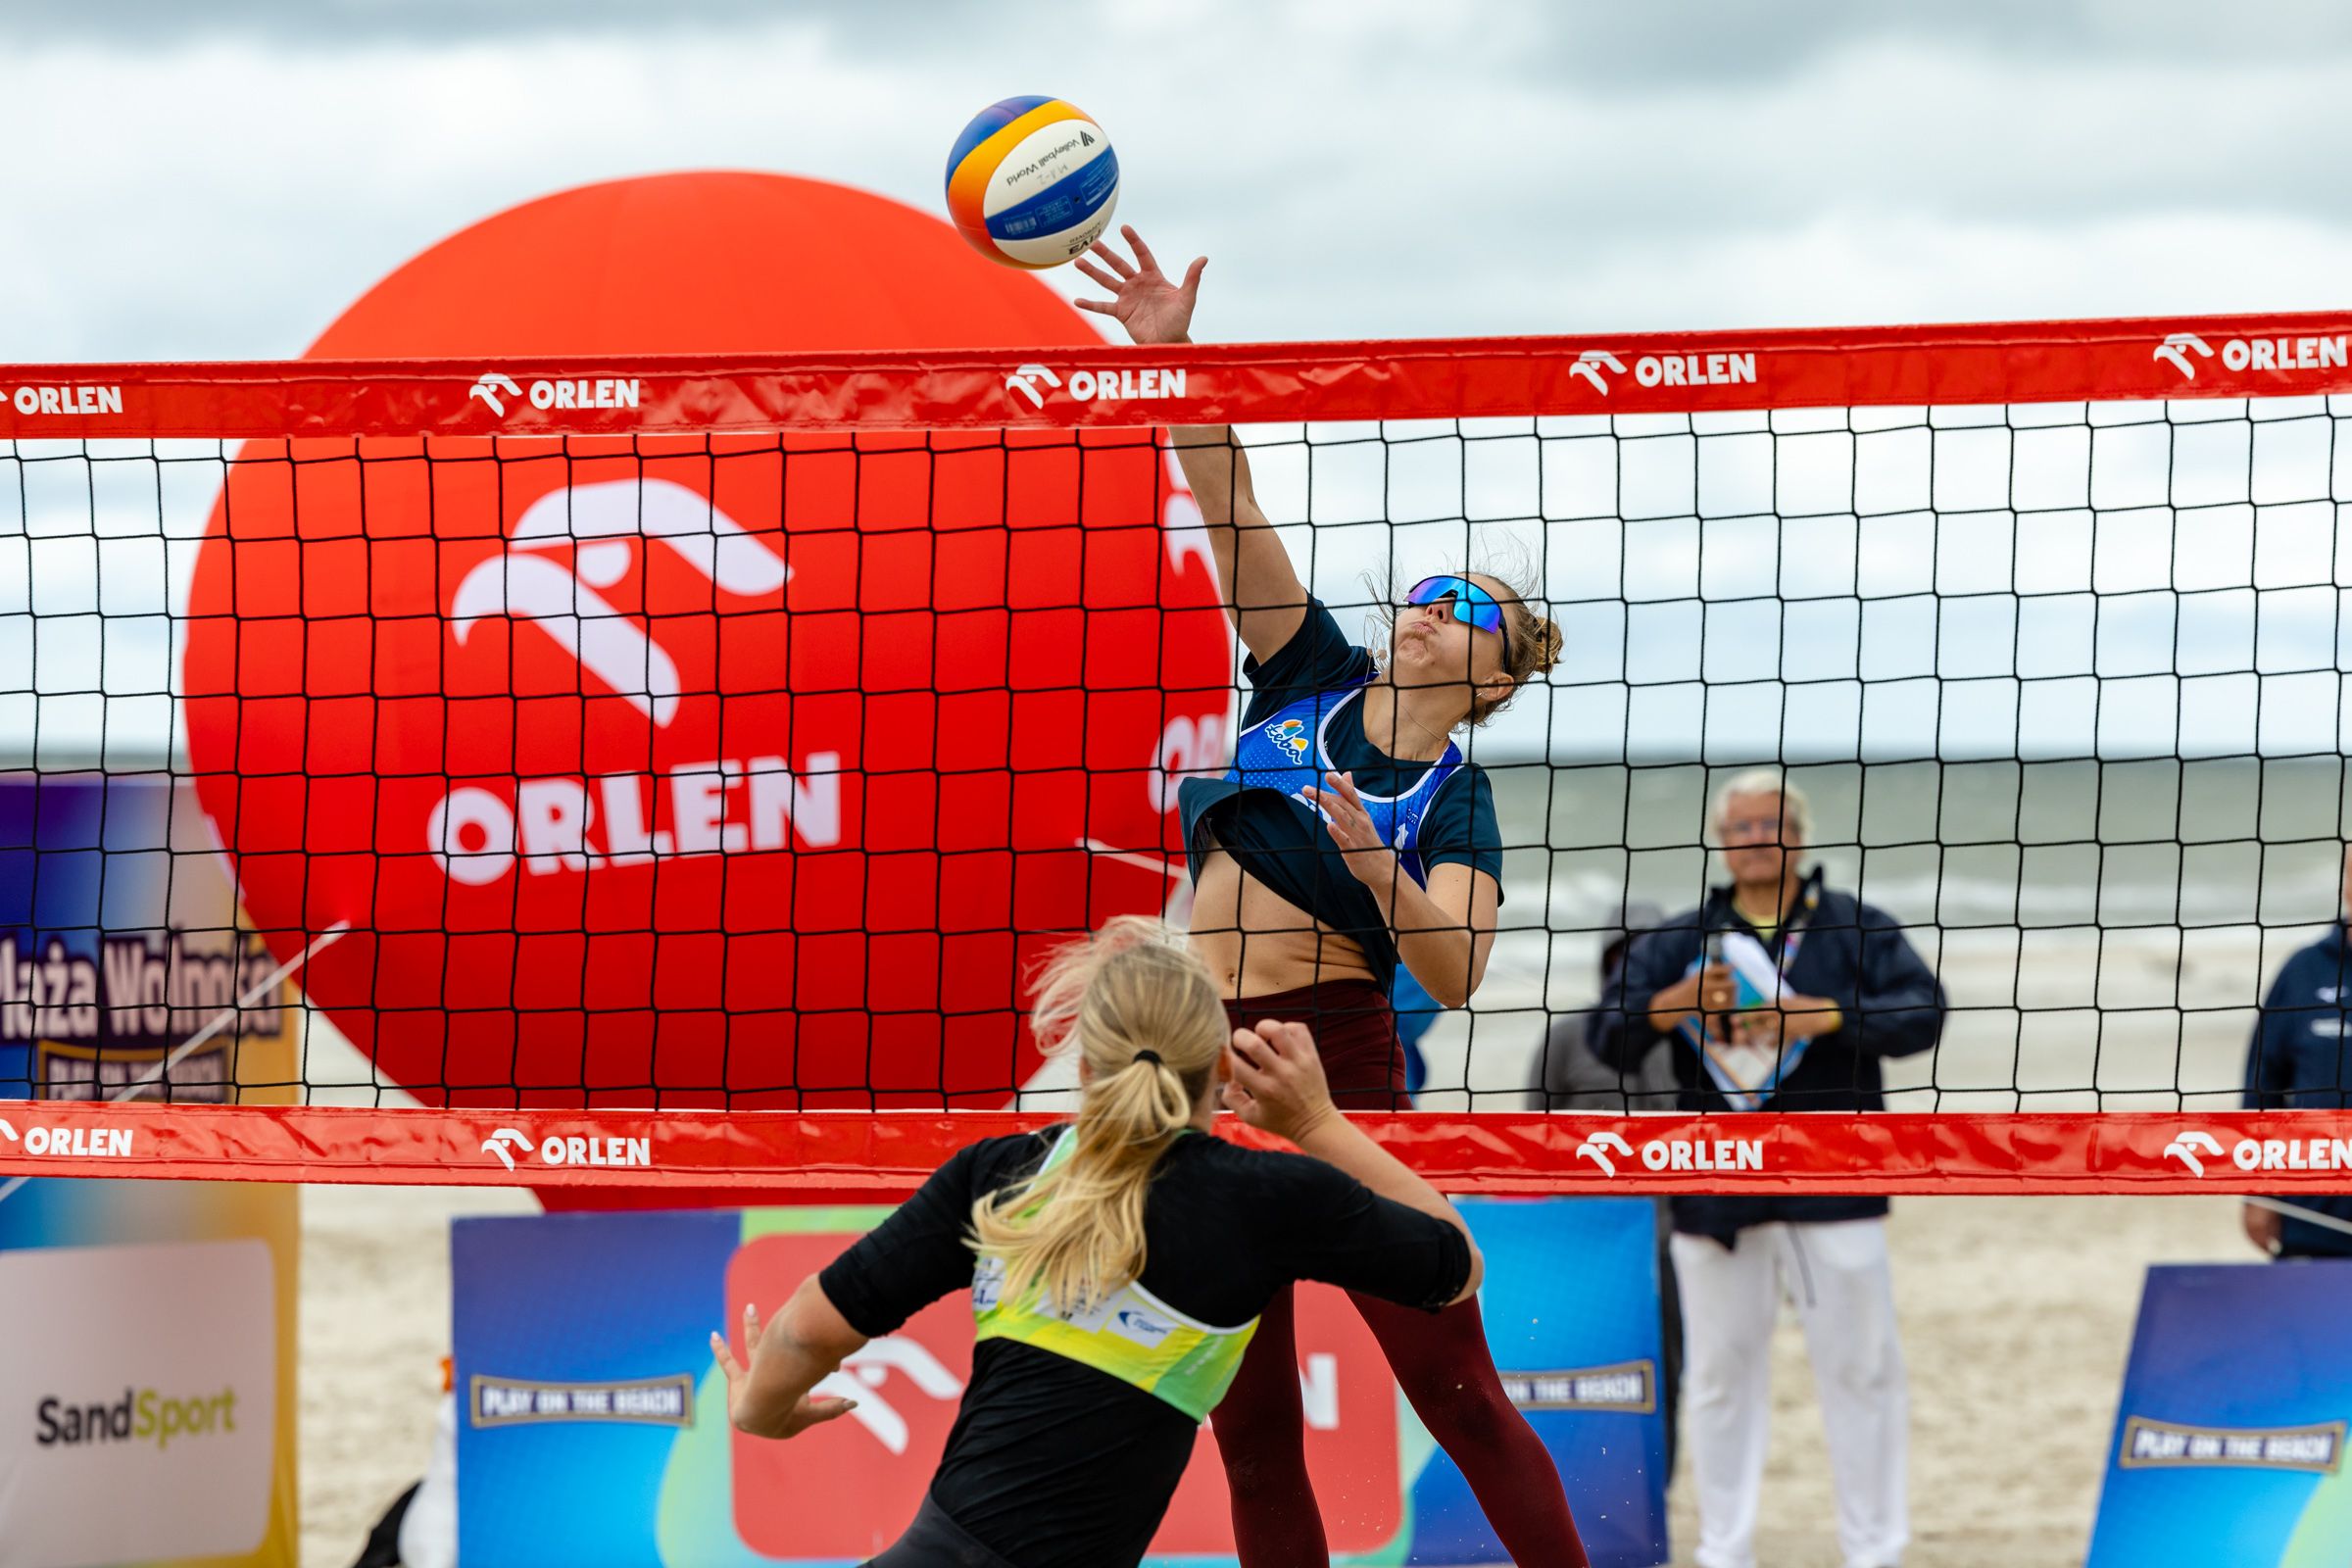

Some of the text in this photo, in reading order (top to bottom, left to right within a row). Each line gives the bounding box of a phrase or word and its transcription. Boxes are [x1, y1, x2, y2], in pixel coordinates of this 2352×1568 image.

[1039, 138, 1080, 167] Volleyball
[1006, 163, 1039, 186] World
[2222, 336, 2347, 371] ORLEN
[1069, 369, 1186, 401] ORLEN
[1636, 353, 1756, 387] ORLEN
[14, 386, 122, 415] ORLEN
[529, 379, 639, 410] ORLEN
[427, 752, 840, 886] ORLEN
[0, 935, 98, 1039] laża
[24, 1127, 133, 1156] ORLEN
[541, 1136, 651, 1166] ORLEN
[1642, 1140, 1763, 1171] ORLEN
[2232, 1138, 2352, 1171] ORLEN
[36, 1386, 236, 1451] SandSport
